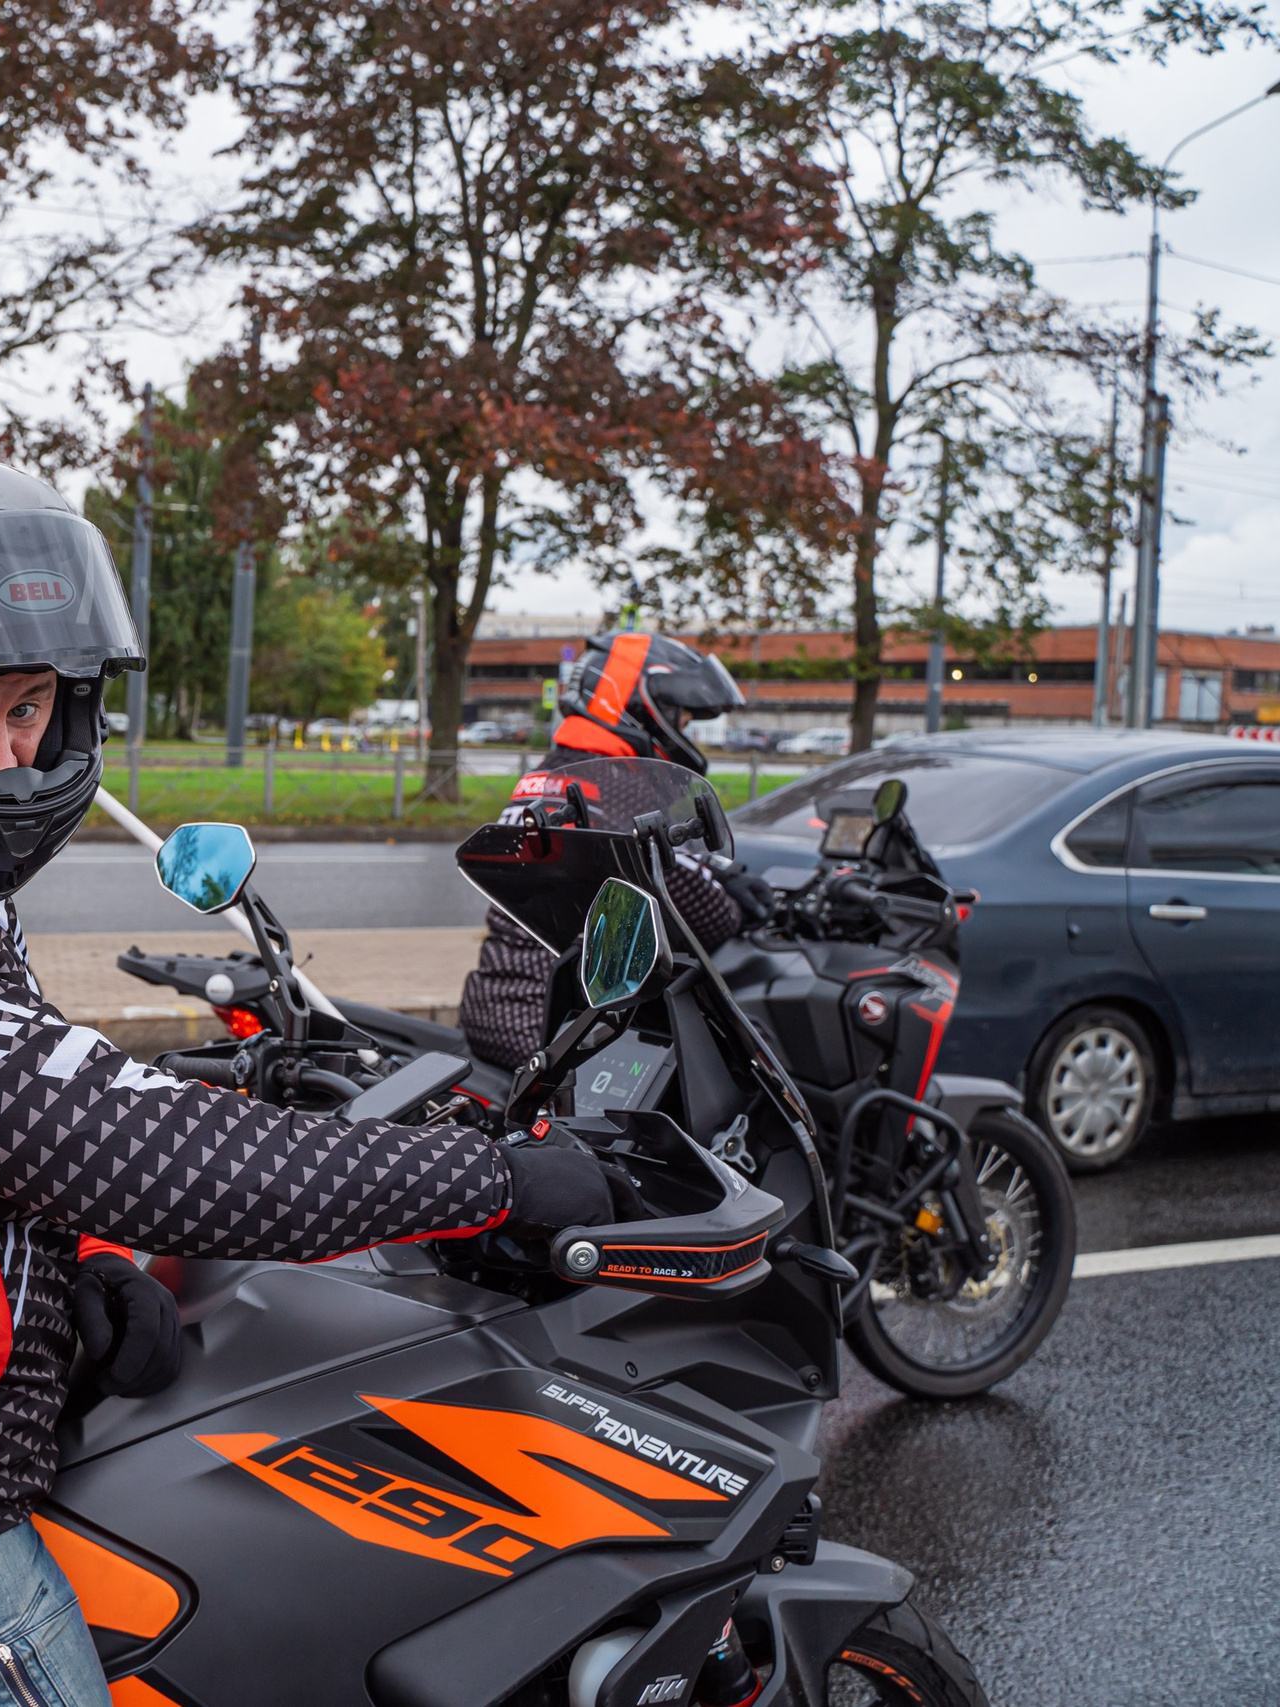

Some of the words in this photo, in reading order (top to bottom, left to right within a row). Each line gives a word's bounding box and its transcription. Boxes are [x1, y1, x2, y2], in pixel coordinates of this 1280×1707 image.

[9, 582, 67, 602] BELL
[590, 1070, 613, 1094] 0
[628, 1061, 644, 1077] N
[607, 1264, 636, 1273] READY
[639, 1266, 652, 1274] TO
[653, 1267, 677, 1276] RACE
[542, 1384, 610, 1419] SUPER
[594, 1417, 749, 1496] ADVENTURE
[247, 1444, 559, 1566] 1290
[637, 1673, 688, 1706] KTM
